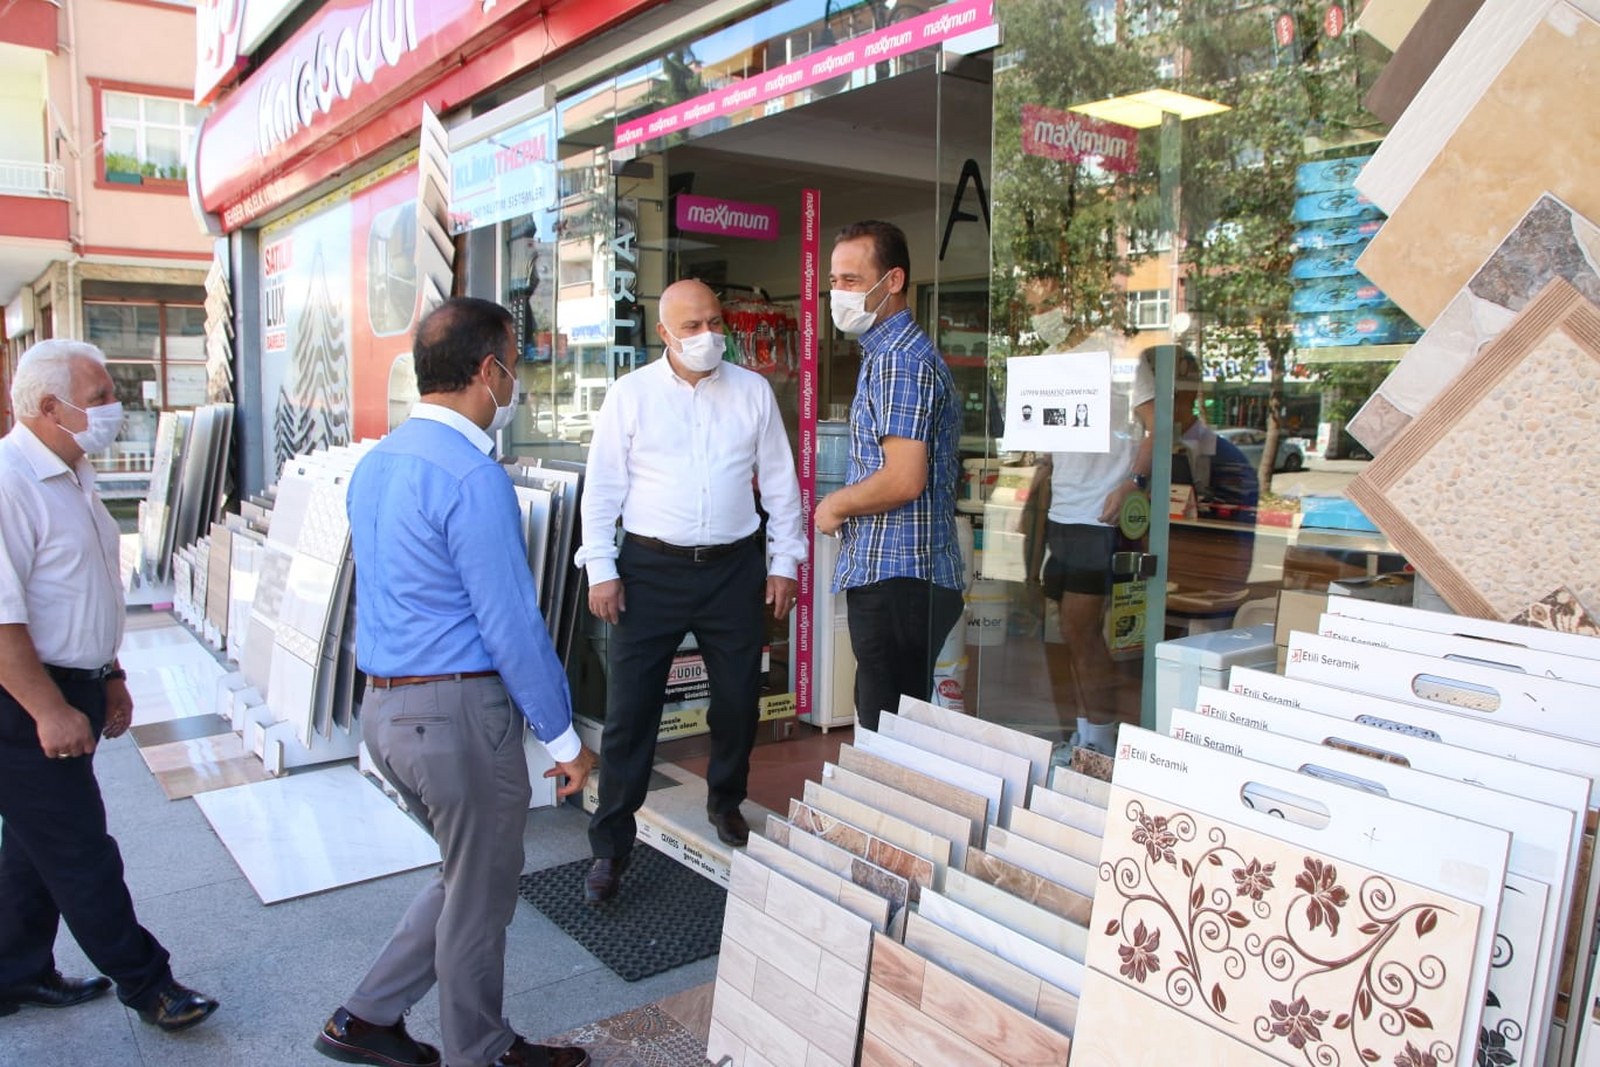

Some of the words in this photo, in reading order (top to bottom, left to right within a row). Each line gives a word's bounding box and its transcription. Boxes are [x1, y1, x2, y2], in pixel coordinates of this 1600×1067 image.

[1302, 651, 1319, 661] Etili
[1321, 654, 1361, 671] Seramik
[1262, 692, 1301, 709] Seramik
[1211, 707, 1228, 721] Etili
[1229, 711, 1269, 730] Seramik
[1185, 731, 1202, 745] Etili
[1203, 736, 1244, 756] Seramik
[1131, 748, 1148, 762] Etili
[1149, 752, 1189, 774] Seramik
